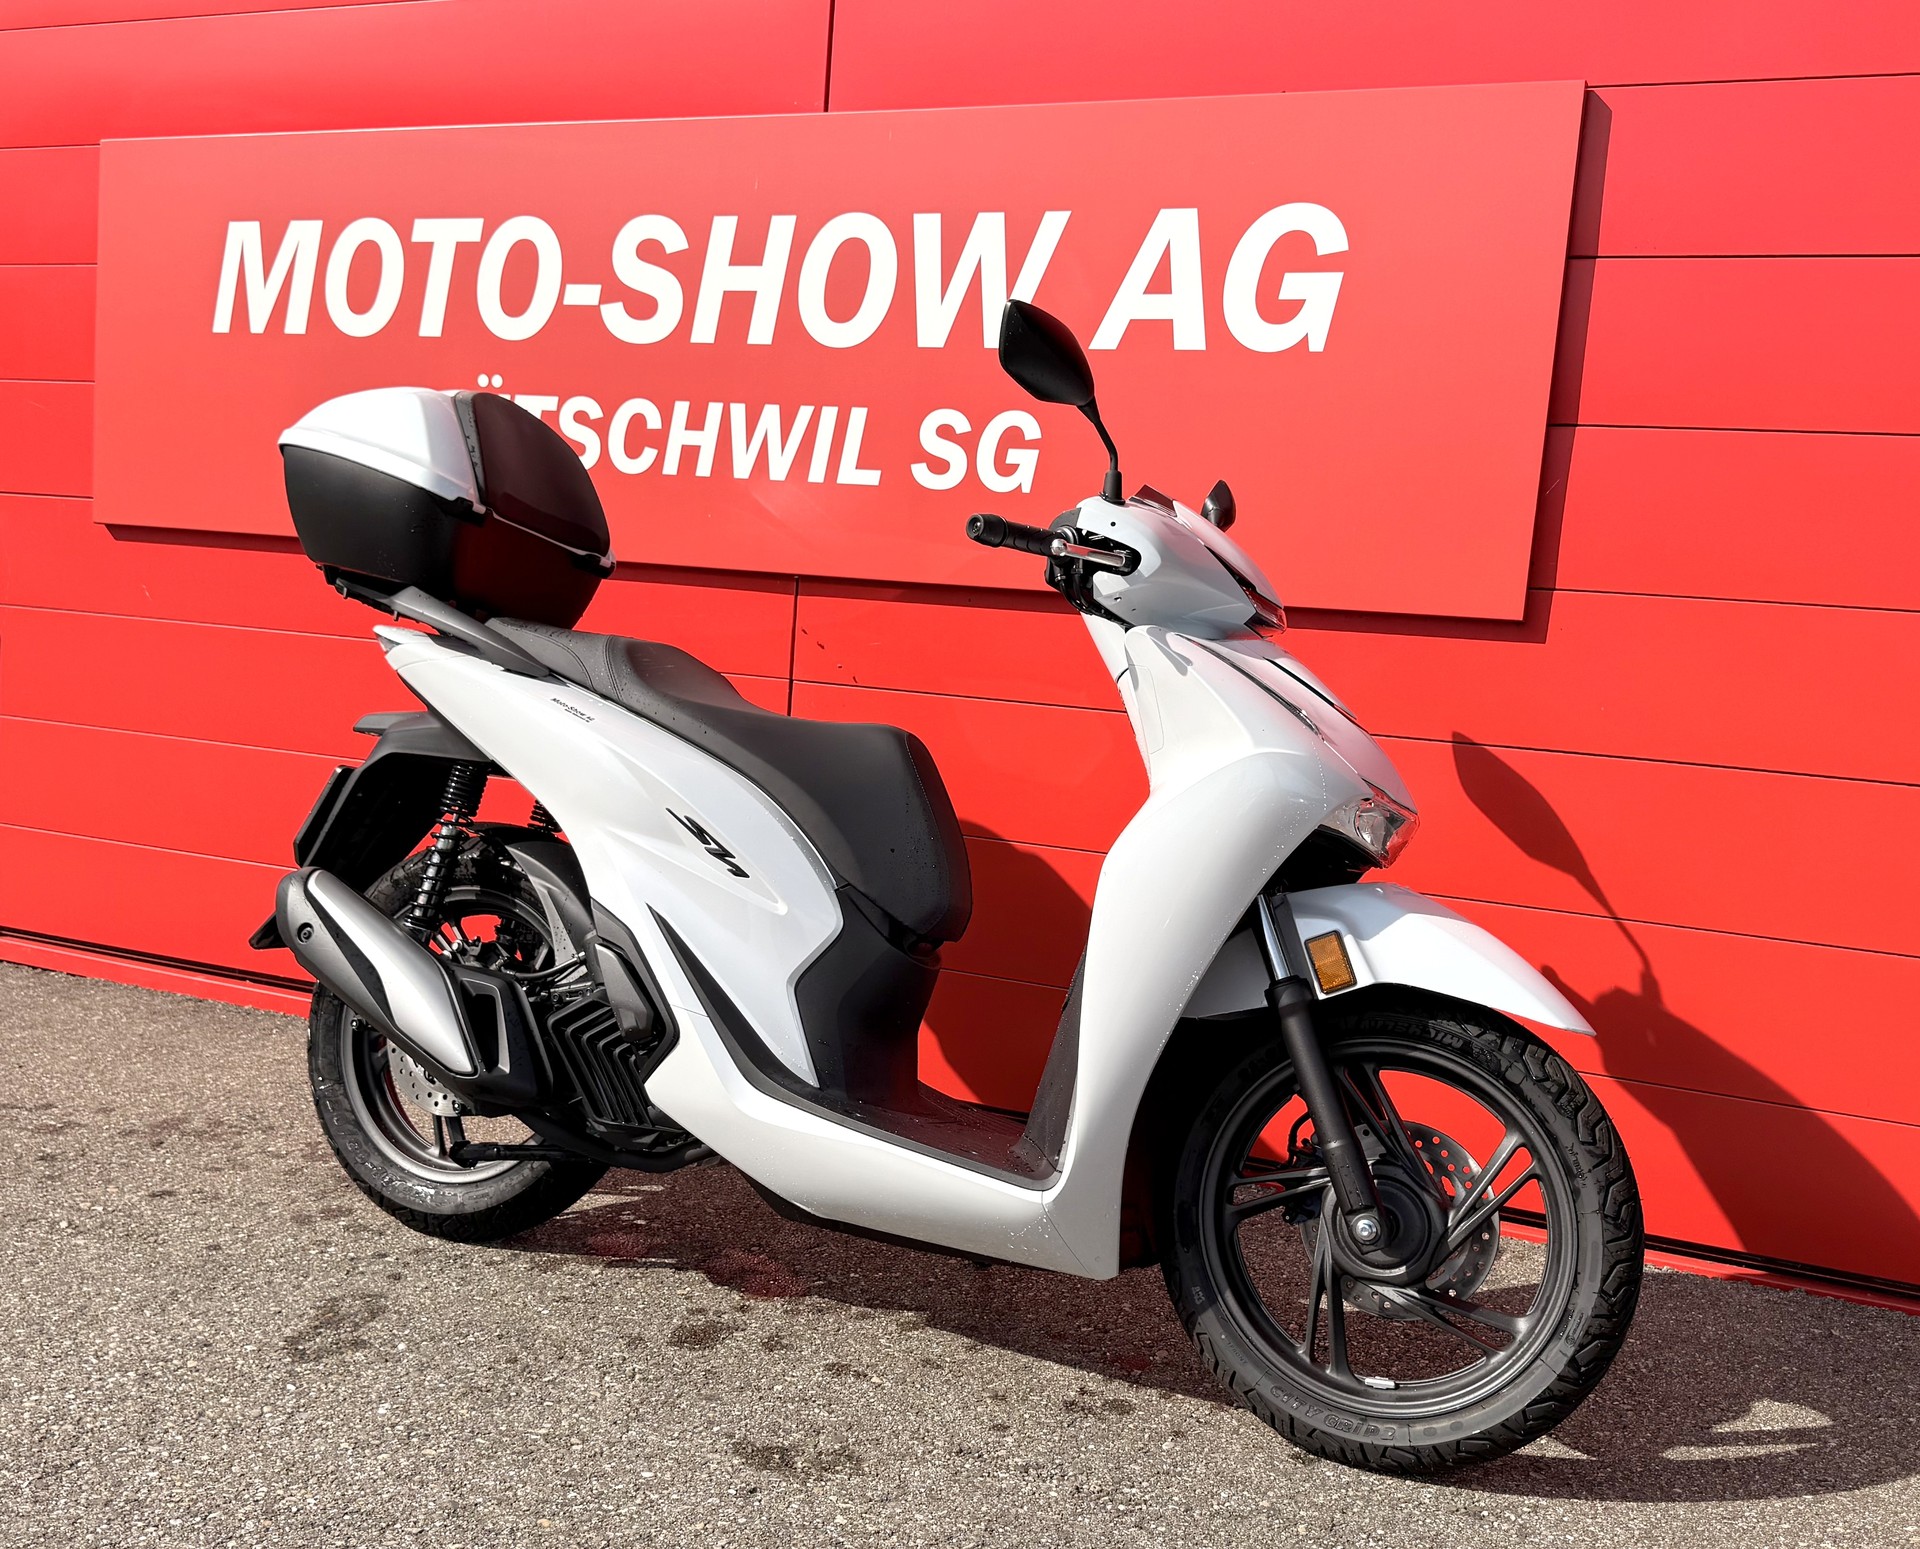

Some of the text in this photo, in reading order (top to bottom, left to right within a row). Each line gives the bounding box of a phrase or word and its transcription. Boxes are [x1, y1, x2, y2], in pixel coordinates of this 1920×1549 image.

[211, 202, 1350, 353] MOTO-SHOW AG
[910, 406, 1043, 494] SG
[1269, 1385, 1325, 1419] CITY
[1323, 1413, 1381, 1438] GRIP
